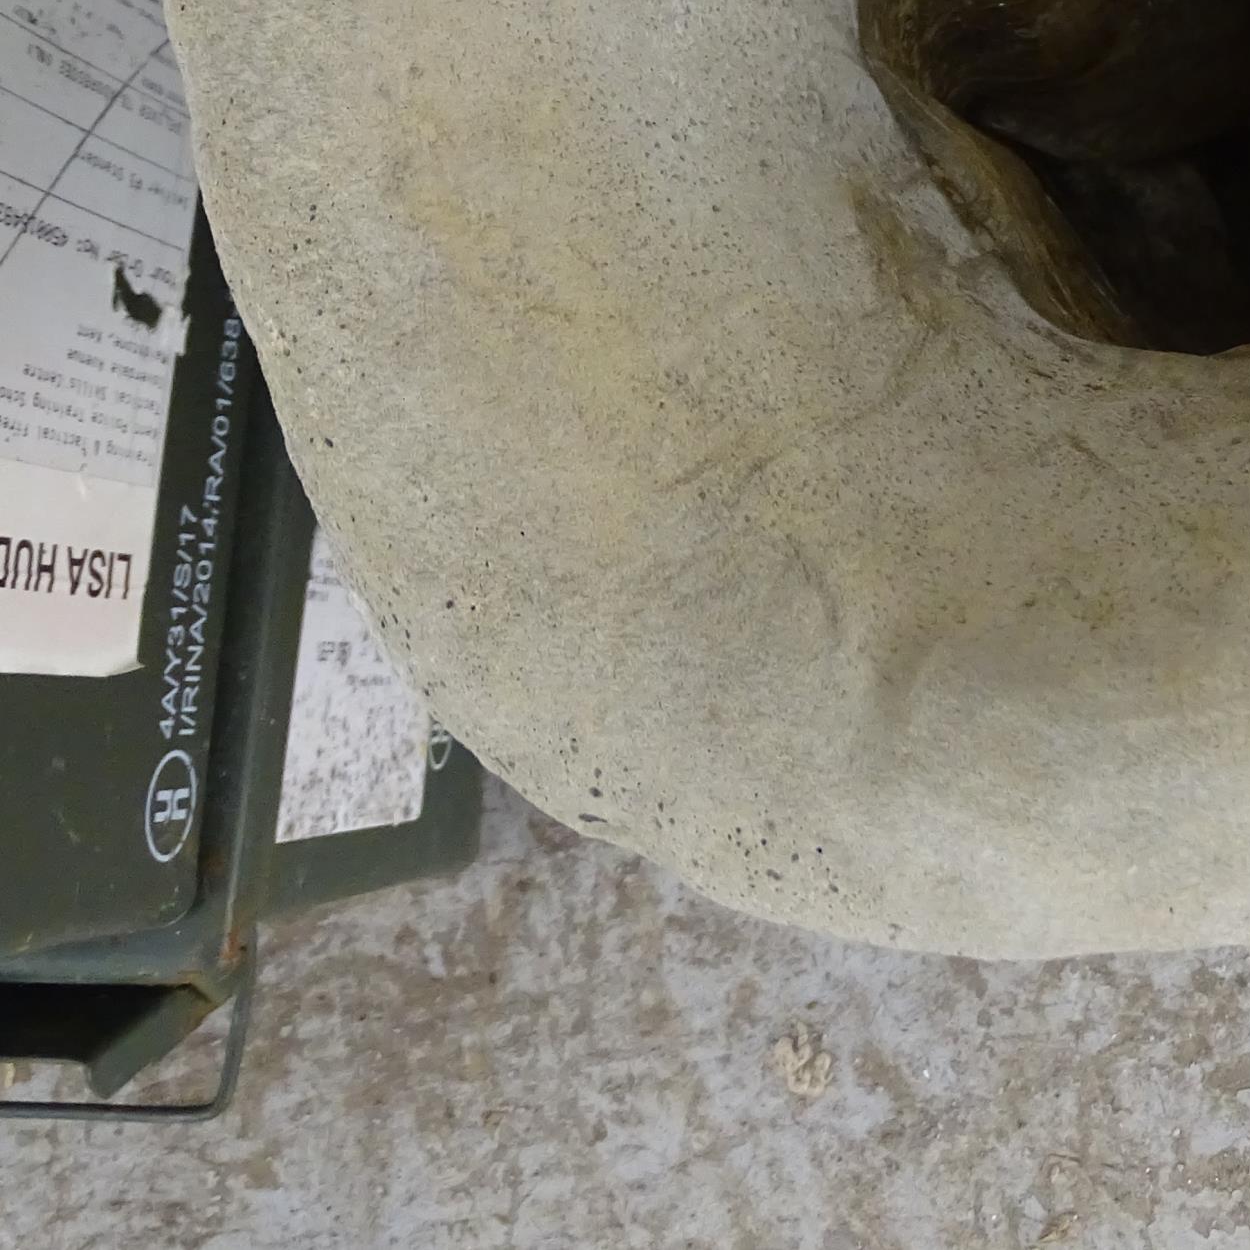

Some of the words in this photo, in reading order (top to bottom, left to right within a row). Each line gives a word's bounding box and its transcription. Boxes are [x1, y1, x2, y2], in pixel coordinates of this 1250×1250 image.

[23, 364, 62, 389] Centre
[32, 391, 84, 423] Training
[67, 546, 132, 600] LISA
